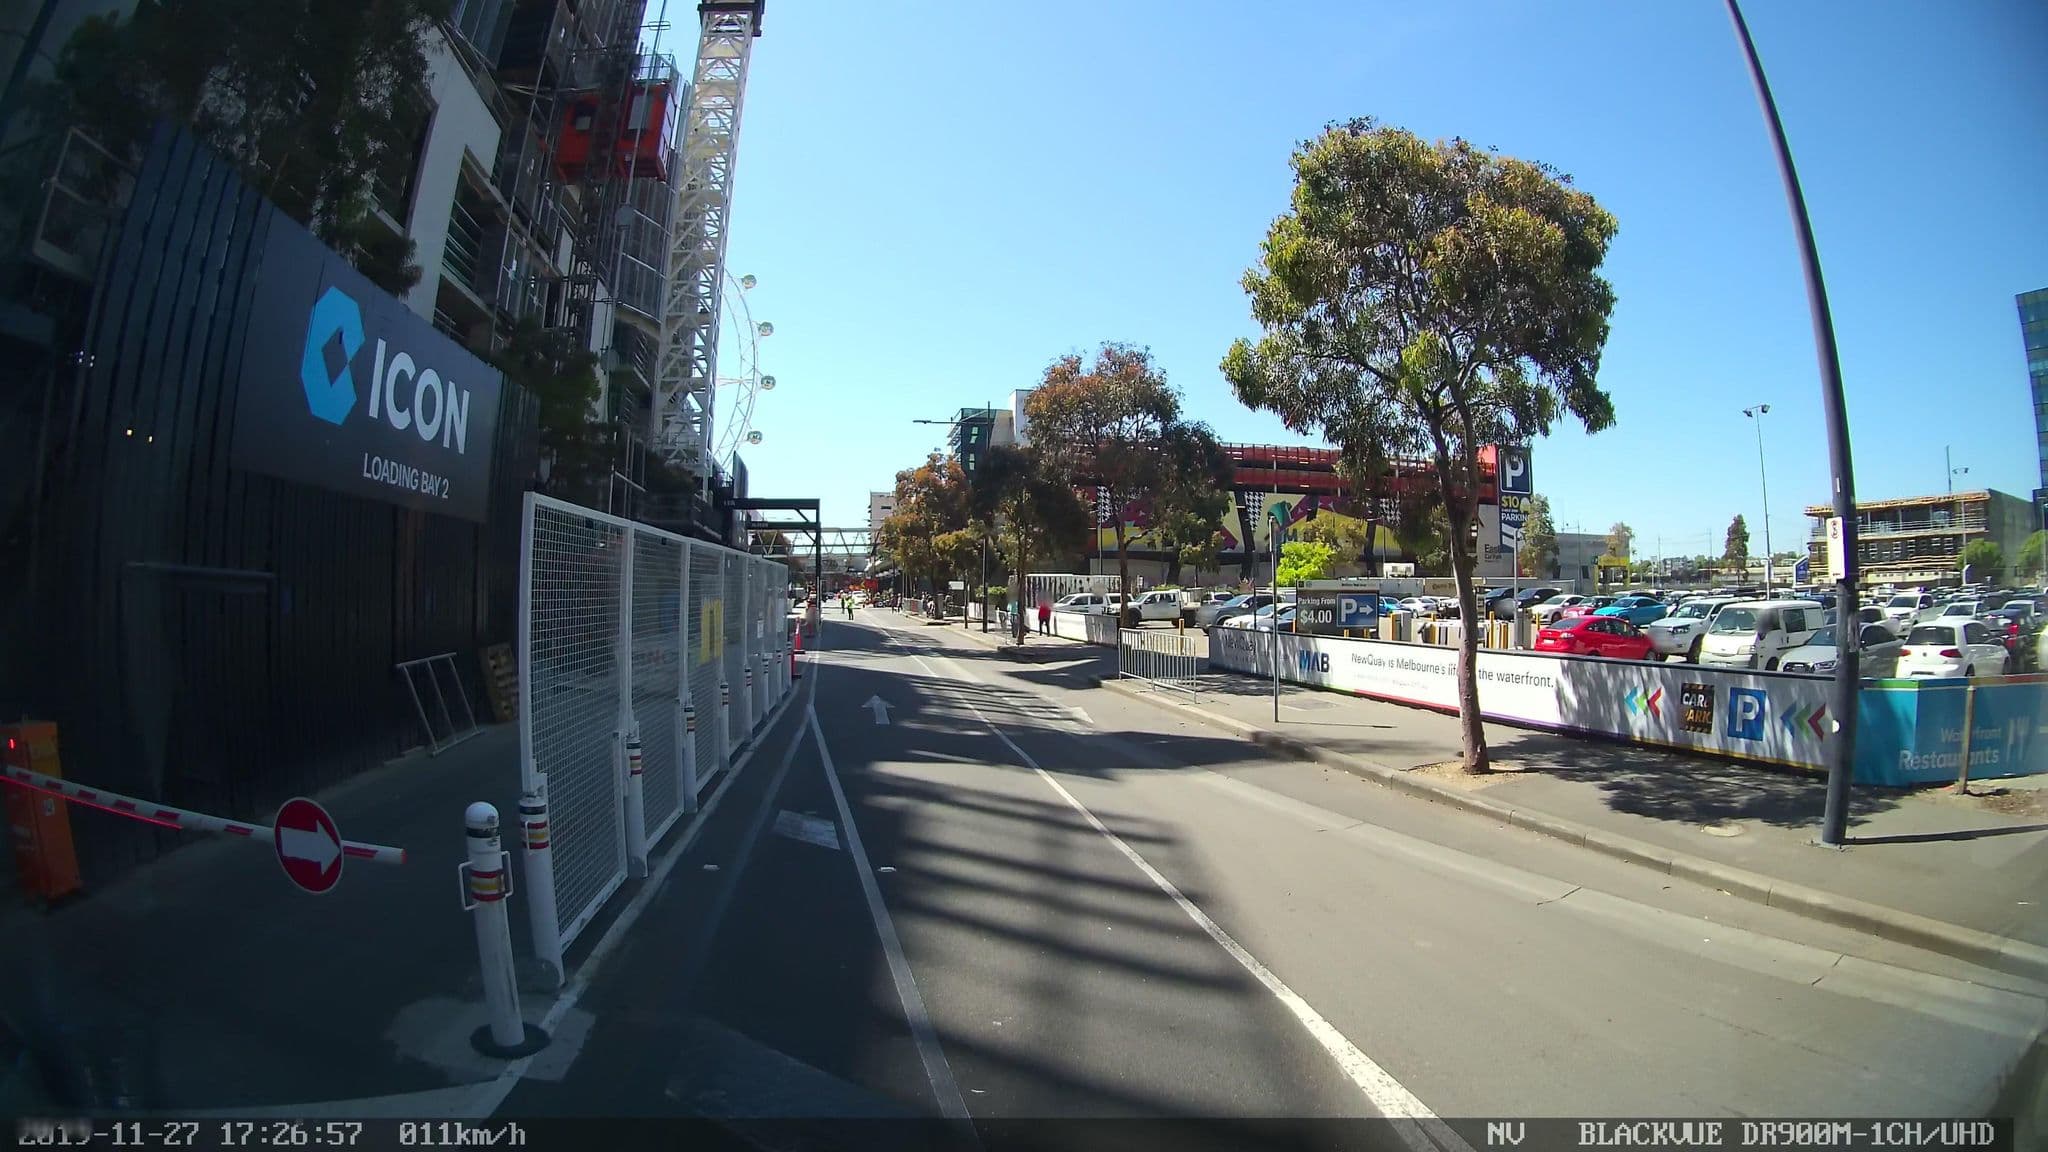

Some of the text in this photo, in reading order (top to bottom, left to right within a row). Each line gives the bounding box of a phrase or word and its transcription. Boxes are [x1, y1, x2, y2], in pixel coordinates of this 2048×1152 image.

[368, 337, 471, 455] ICON
[363, 452, 450, 499] LOADING BAY 2
[1505, 455, 1524, 488] P
[1501, 512, 1529, 522] PARKIN
[1297, 597, 1336, 606] Parking From
[1340, 598, 1358, 623] P
[1300, 609, 1333, 625] $4.00
[1299, 650, 1330, 673] MAB
[1350, 652, 1386, 668] NewQuay
[1388, 658, 1395, 669] is
[1396, 658, 1446, 676] Melbourne's
[1478, 667, 1494, 682] the
[1496, 671, 1554, 689] waterfront.
[1682, 692, 1705, 708] CAR
[1735, 694, 1760, 732] P
[1940, 726, 2001, 744] Warfront
[1899, 746, 2000, 771] Restaunts
